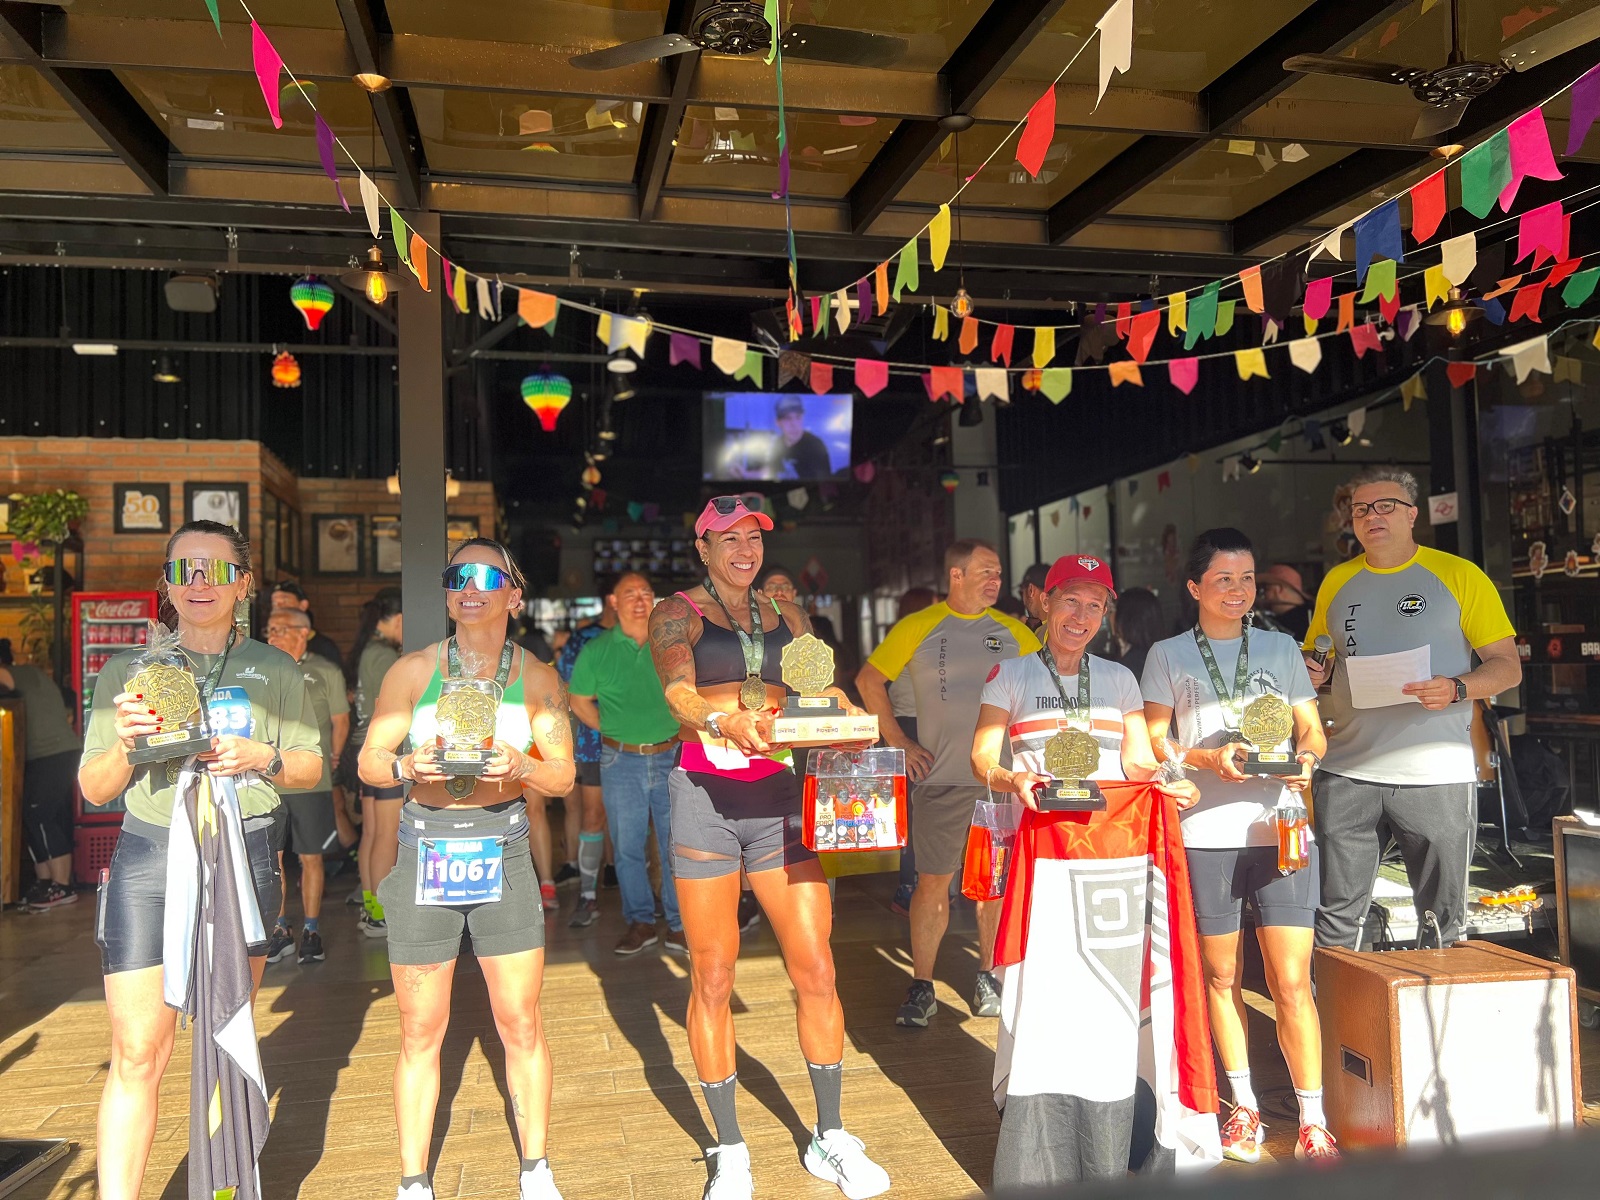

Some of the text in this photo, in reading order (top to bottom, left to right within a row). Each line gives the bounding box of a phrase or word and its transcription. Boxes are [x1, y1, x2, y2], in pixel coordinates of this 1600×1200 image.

[126, 496, 157, 514] 50
[939, 638, 947, 701] PERSONAL
[1036, 696, 1079, 709] TRICOO
[435, 857, 501, 883] 1067
